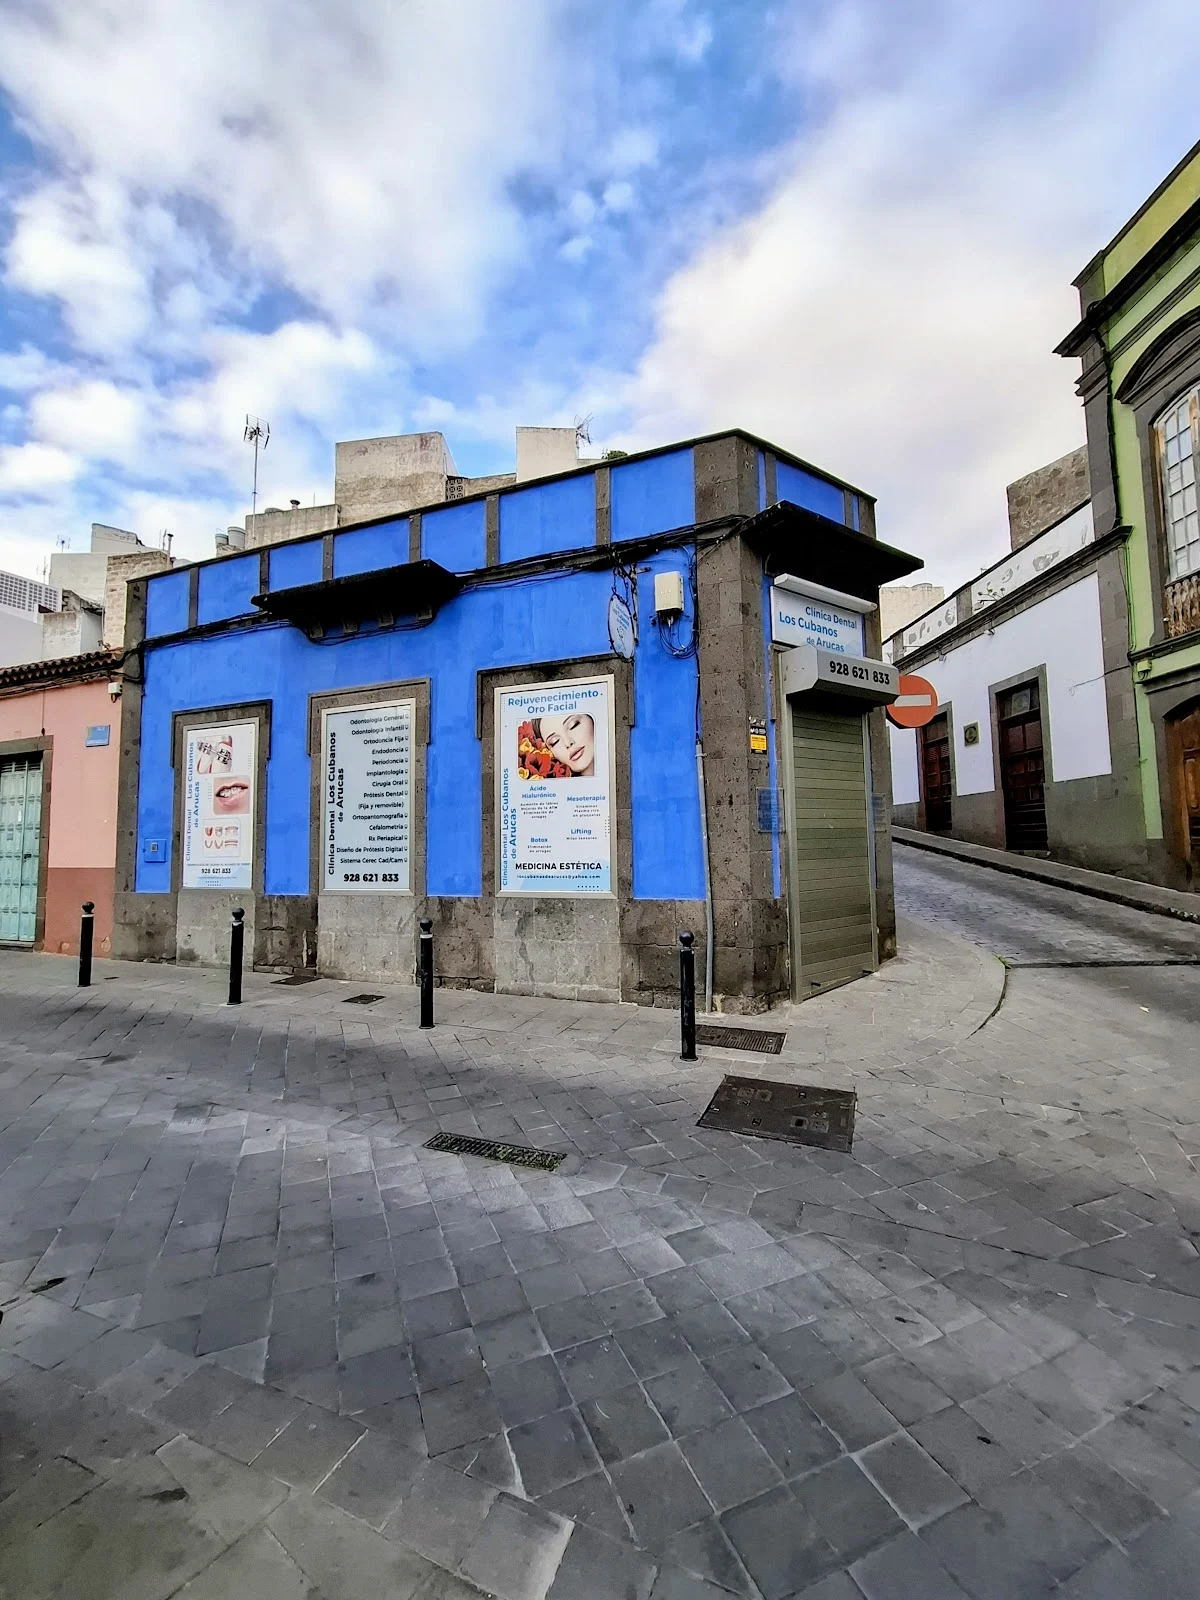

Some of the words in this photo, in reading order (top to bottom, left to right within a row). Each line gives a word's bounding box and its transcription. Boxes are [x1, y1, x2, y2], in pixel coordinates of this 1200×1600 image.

[779, 611, 796, 626] Los
[798, 618, 838, 637] Cubanos
[833, 614, 857, 629] Dental
[806, 636, 815, 644] de
[816, 637, 844, 652] Arucas
[830, 660, 849, 676] 928
[852, 666, 869, 680] 621
[873, 671, 890, 685] 833
[508, 690, 599, 706] Rejuvenecimiento
[527, 705, 545, 714] Oro
[548, 701, 577, 712] Facial
[194, 818, 198, 828] de
[338, 812, 343, 822] de
[510, 849, 516, 859] de
[560, 861, 602, 870] ESTÉTICA
[344, 874, 360, 882] 928
[363, 874, 378, 882] 621
[382, 874, 399, 882] 833
